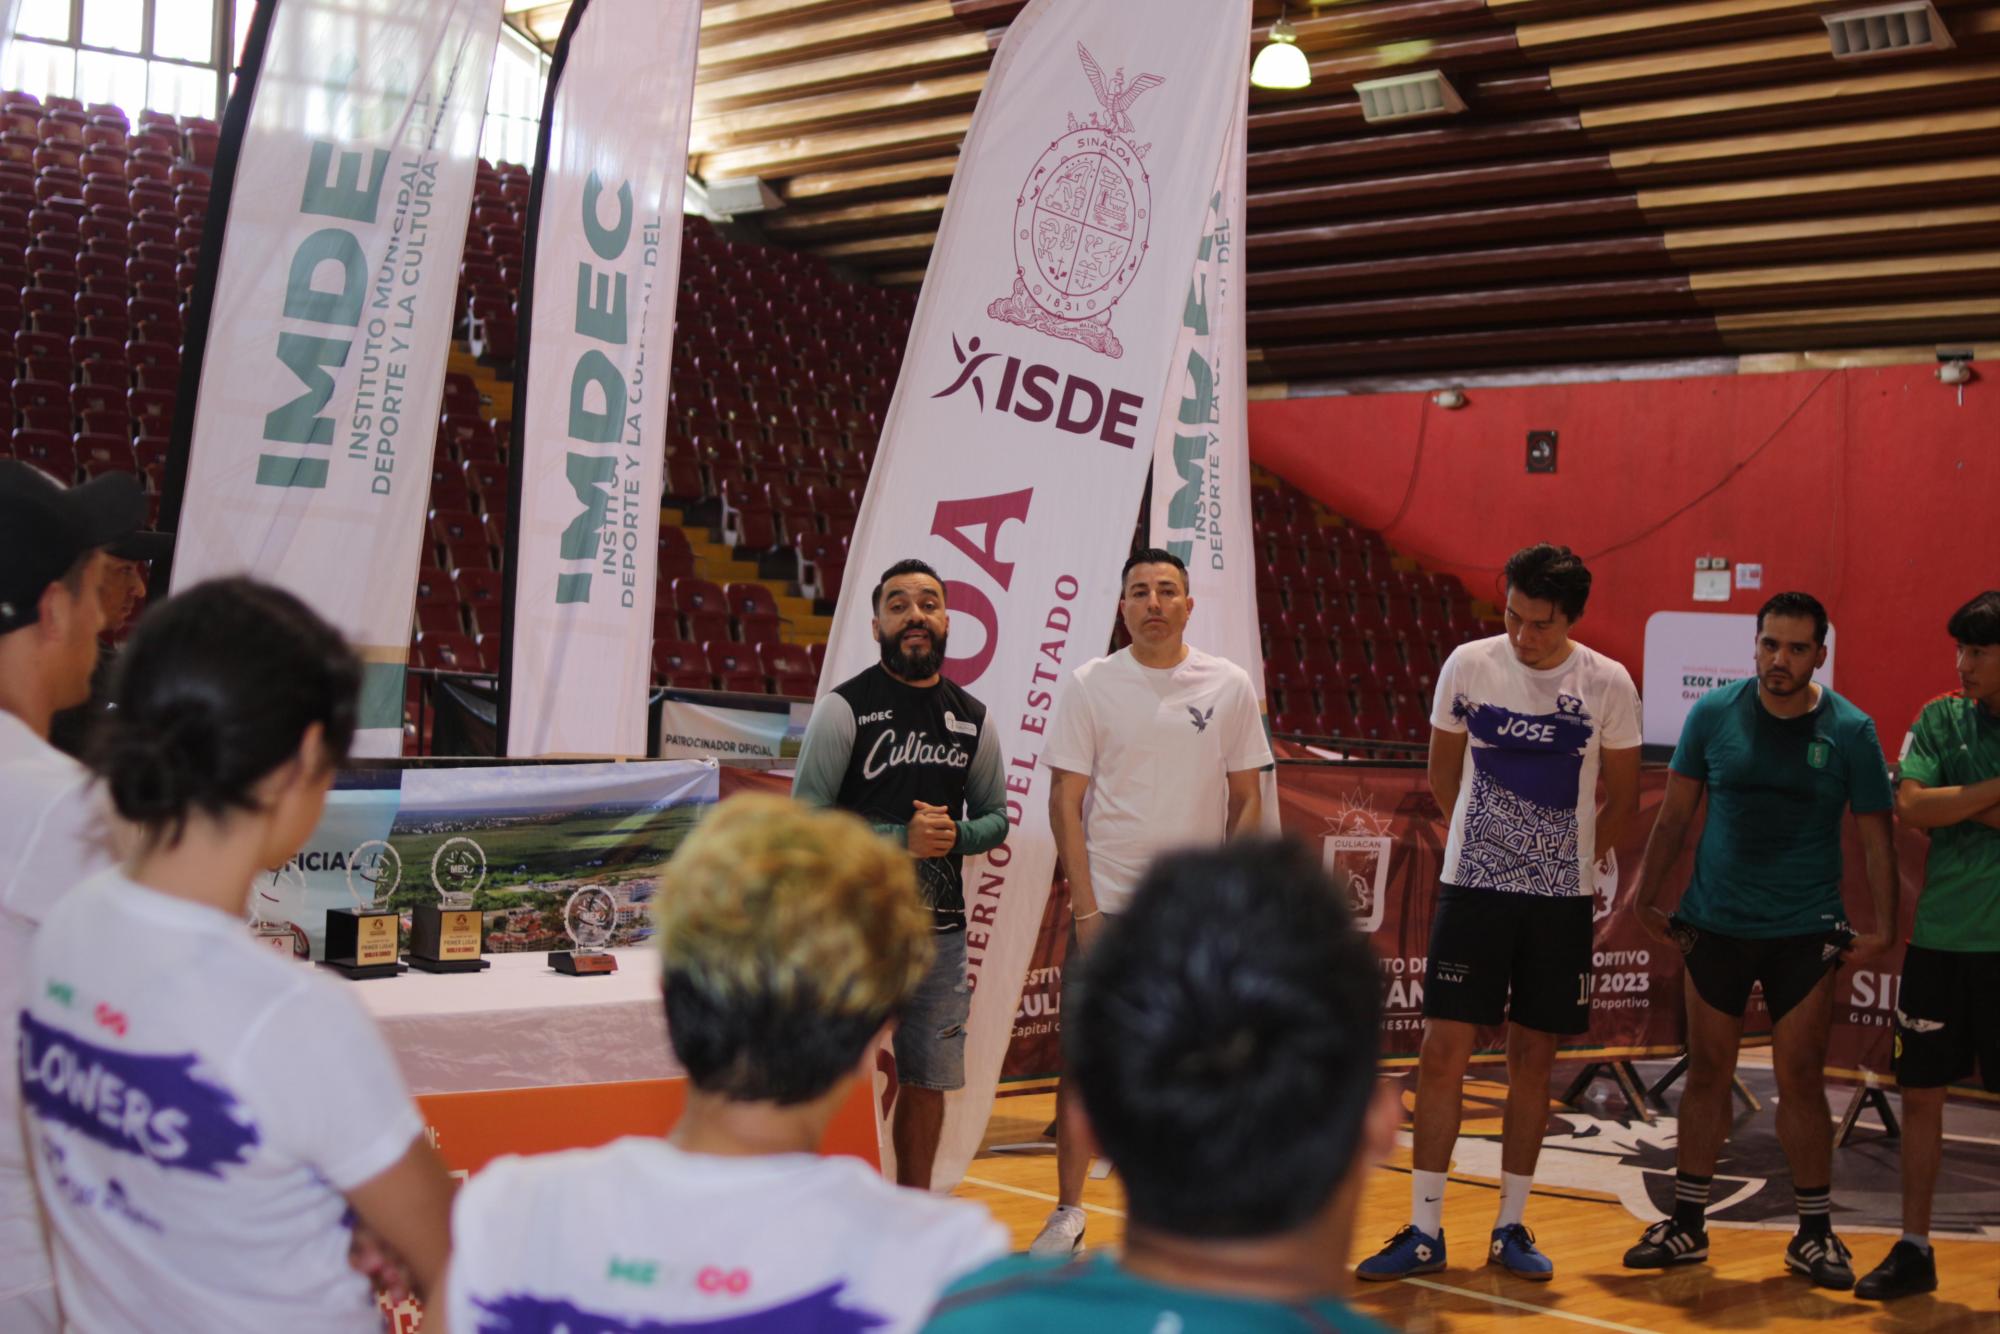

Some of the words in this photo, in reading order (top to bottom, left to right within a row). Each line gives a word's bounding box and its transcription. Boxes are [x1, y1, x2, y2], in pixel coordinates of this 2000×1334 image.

[1077, 138, 1131, 167] SINALOA
[402, 161, 440, 286] CULTURA
[644, 215, 661, 267] DEL
[1214, 218, 1231, 264] DEL
[348, 318, 387, 460] INSTITUTO
[372, 154, 422, 309] MUNICIPAL
[394, 295, 417, 329] LA
[390, 336, 410, 353] Y
[555, 167, 634, 605] IMDEC
[995, 355, 1145, 450] ISDE
[1208, 396, 1221, 424] LA
[371, 362, 407, 496] DEPORTE
[626, 413, 642, 446] LA
[1208, 430, 1220, 446] Y
[625, 453, 641, 470] Y
[1209, 454, 1224, 570] DEPORTE
[621, 479, 640, 608] DEPORTE
[1020, 574, 1080, 736] ESTADO
[1682, 675, 1712, 687] 2023
[665, 734, 736, 753] PATROCINADOR
[738, 743, 775, 757] OFICIAL
[1497, 717, 1557, 742] JOSE
[1004, 753, 1038, 827] DEL
[450, 864, 469, 876] MEX
[1600, 972, 1650, 993] 2023
[1592, 998, 1650, 1012] Deportivo
